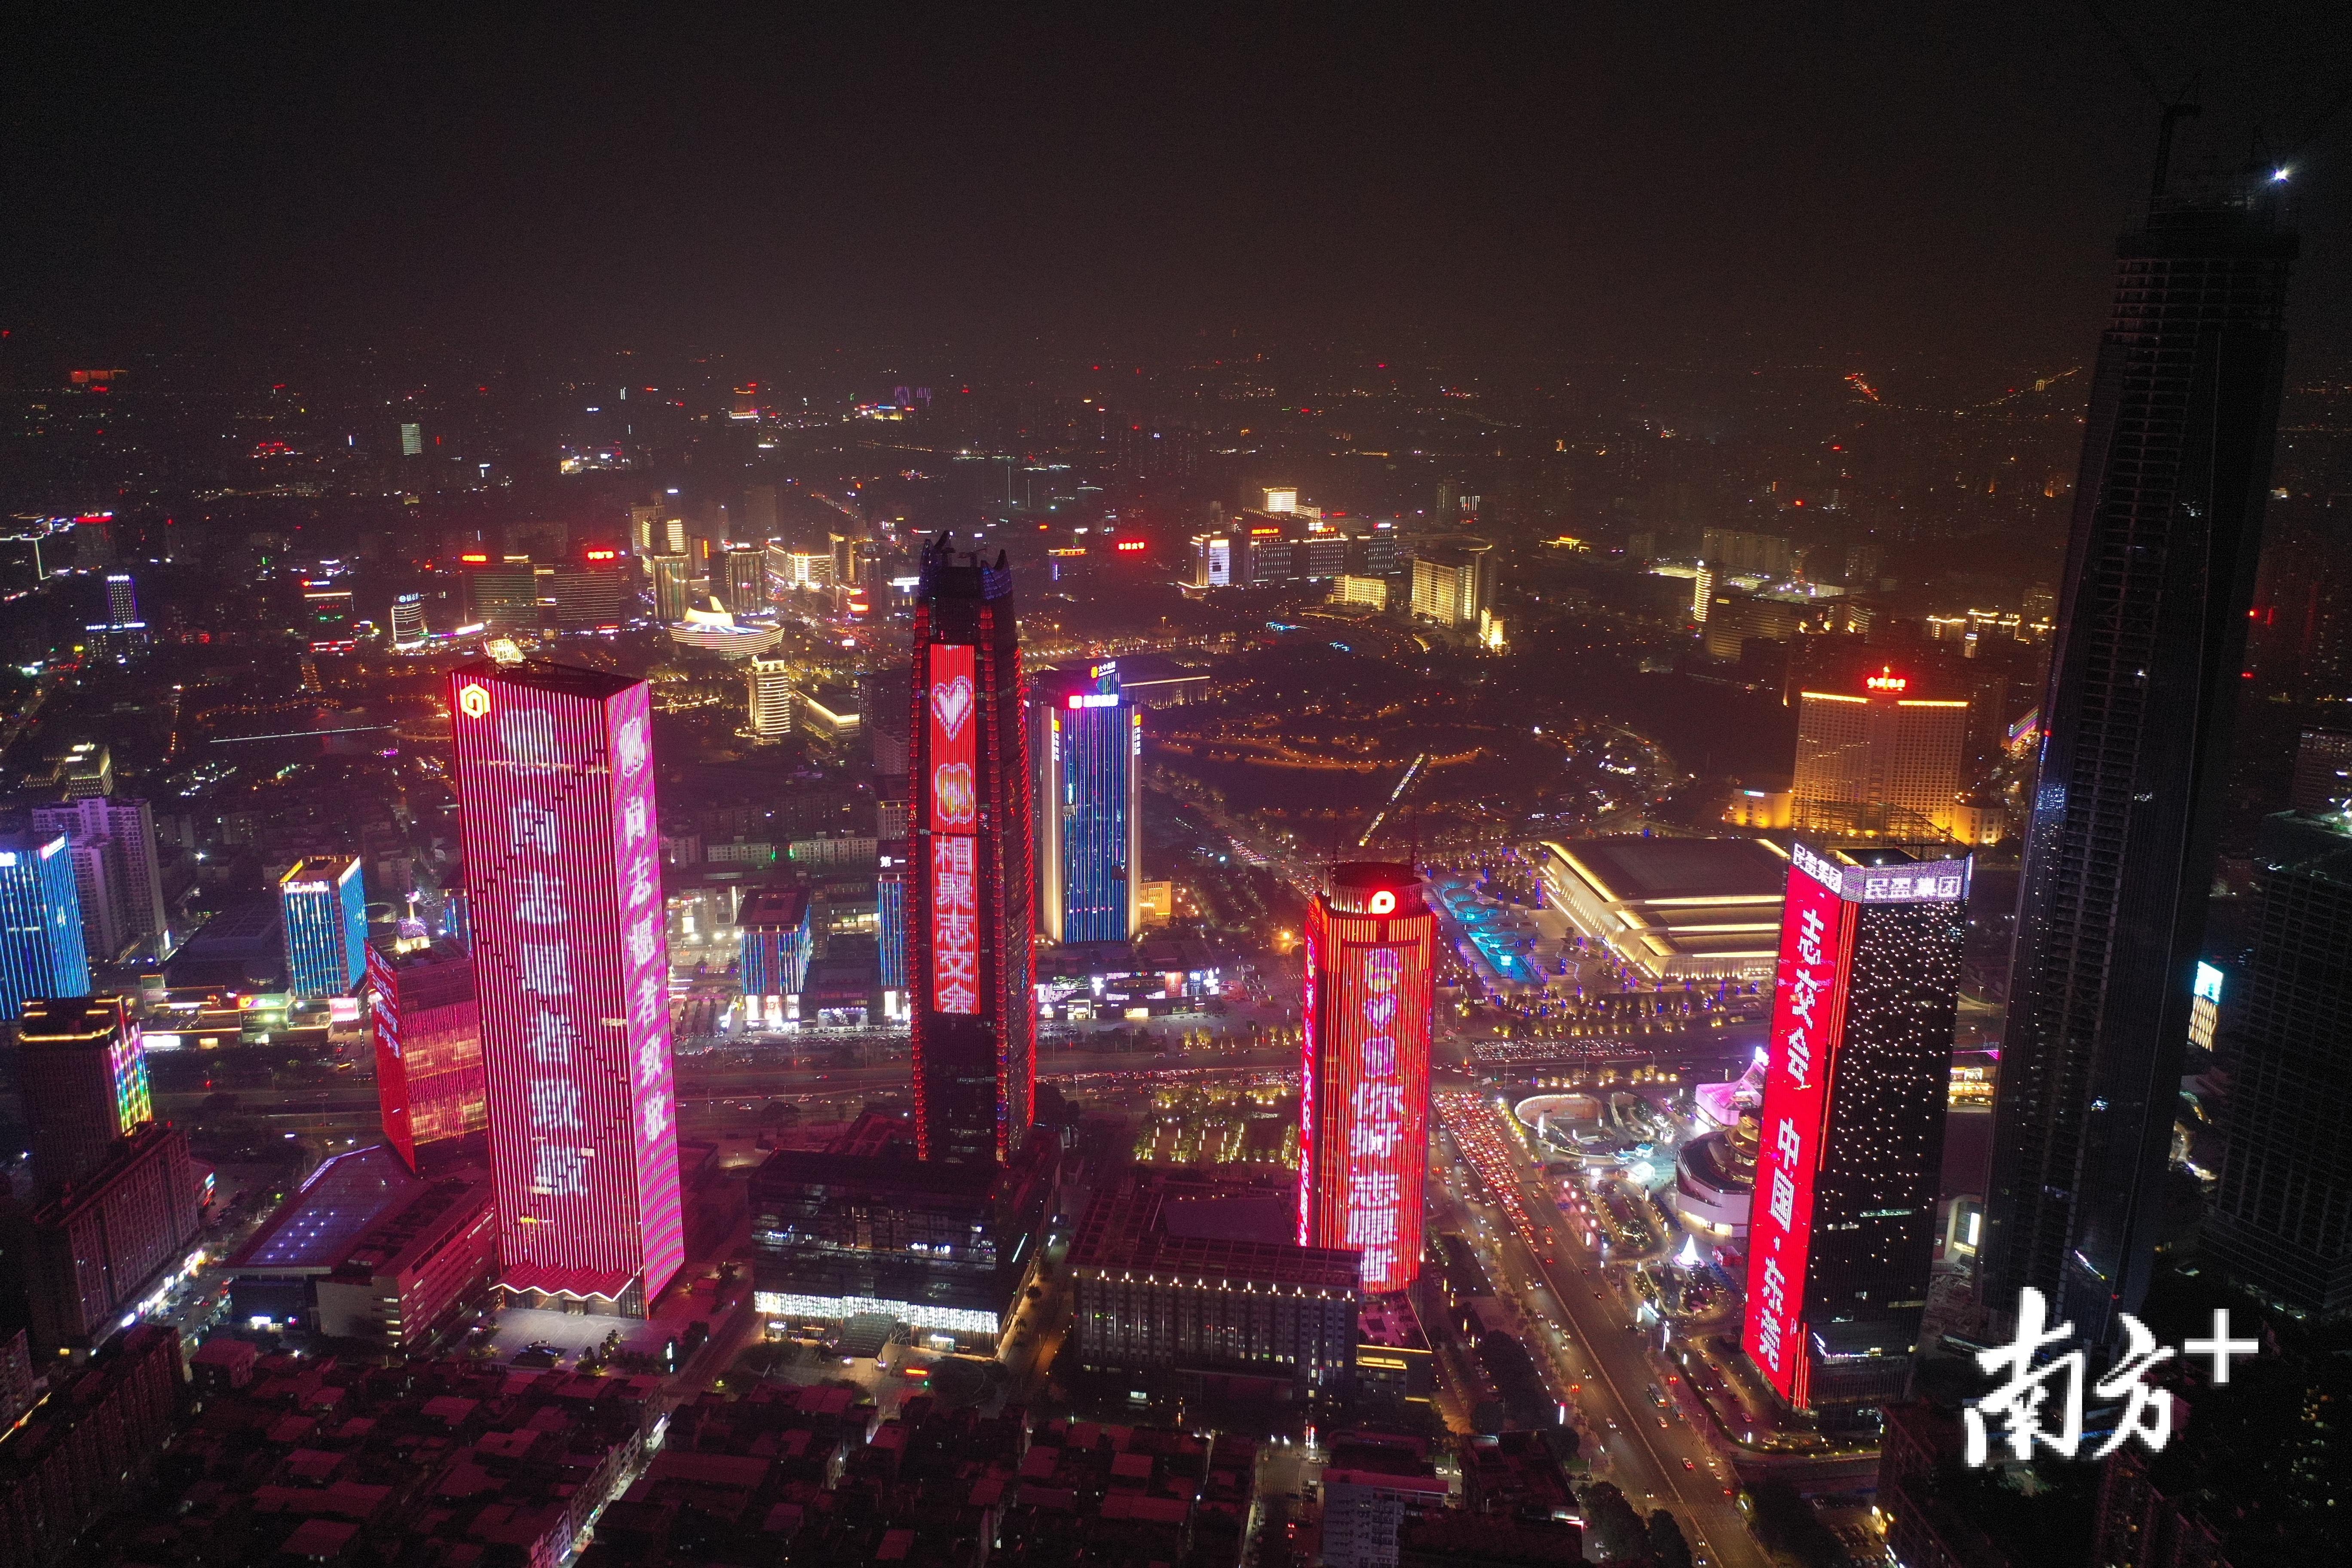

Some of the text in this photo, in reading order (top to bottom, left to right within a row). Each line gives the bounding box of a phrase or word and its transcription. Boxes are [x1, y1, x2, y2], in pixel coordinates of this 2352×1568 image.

[935, 837, 975, 1014] 相聚志交会
[1787, 908, 1824, 1087] 志交会
[1348, 1082, 1403, 1282] 你好 志愿者
